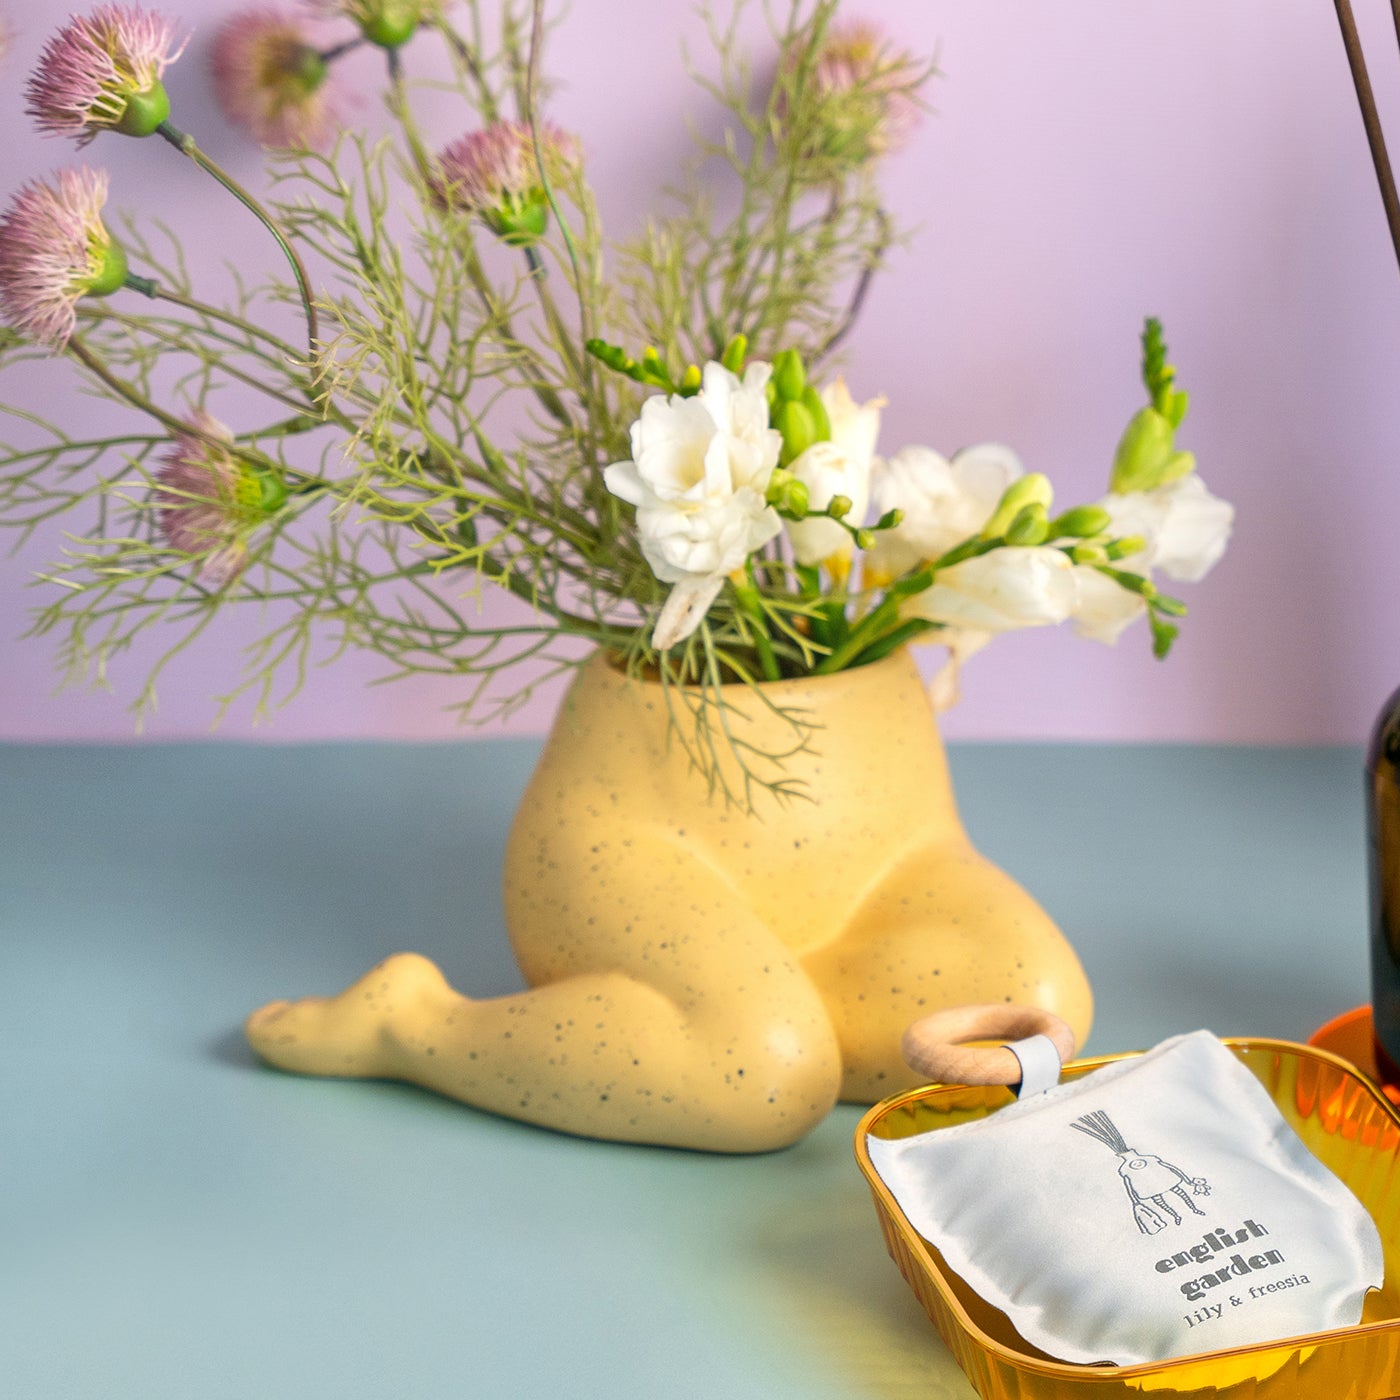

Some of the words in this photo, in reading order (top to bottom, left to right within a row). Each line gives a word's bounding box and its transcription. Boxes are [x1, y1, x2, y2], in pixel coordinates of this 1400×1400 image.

[1155, 1219, 1269, 1274] english
[1180, 1248, 1286, 1302] garden
[1183, 1303, 1224, 1329] lily
[1229, 1295, 1243, 1307] &
[1249, 1274, 1311, 1300] freesia
